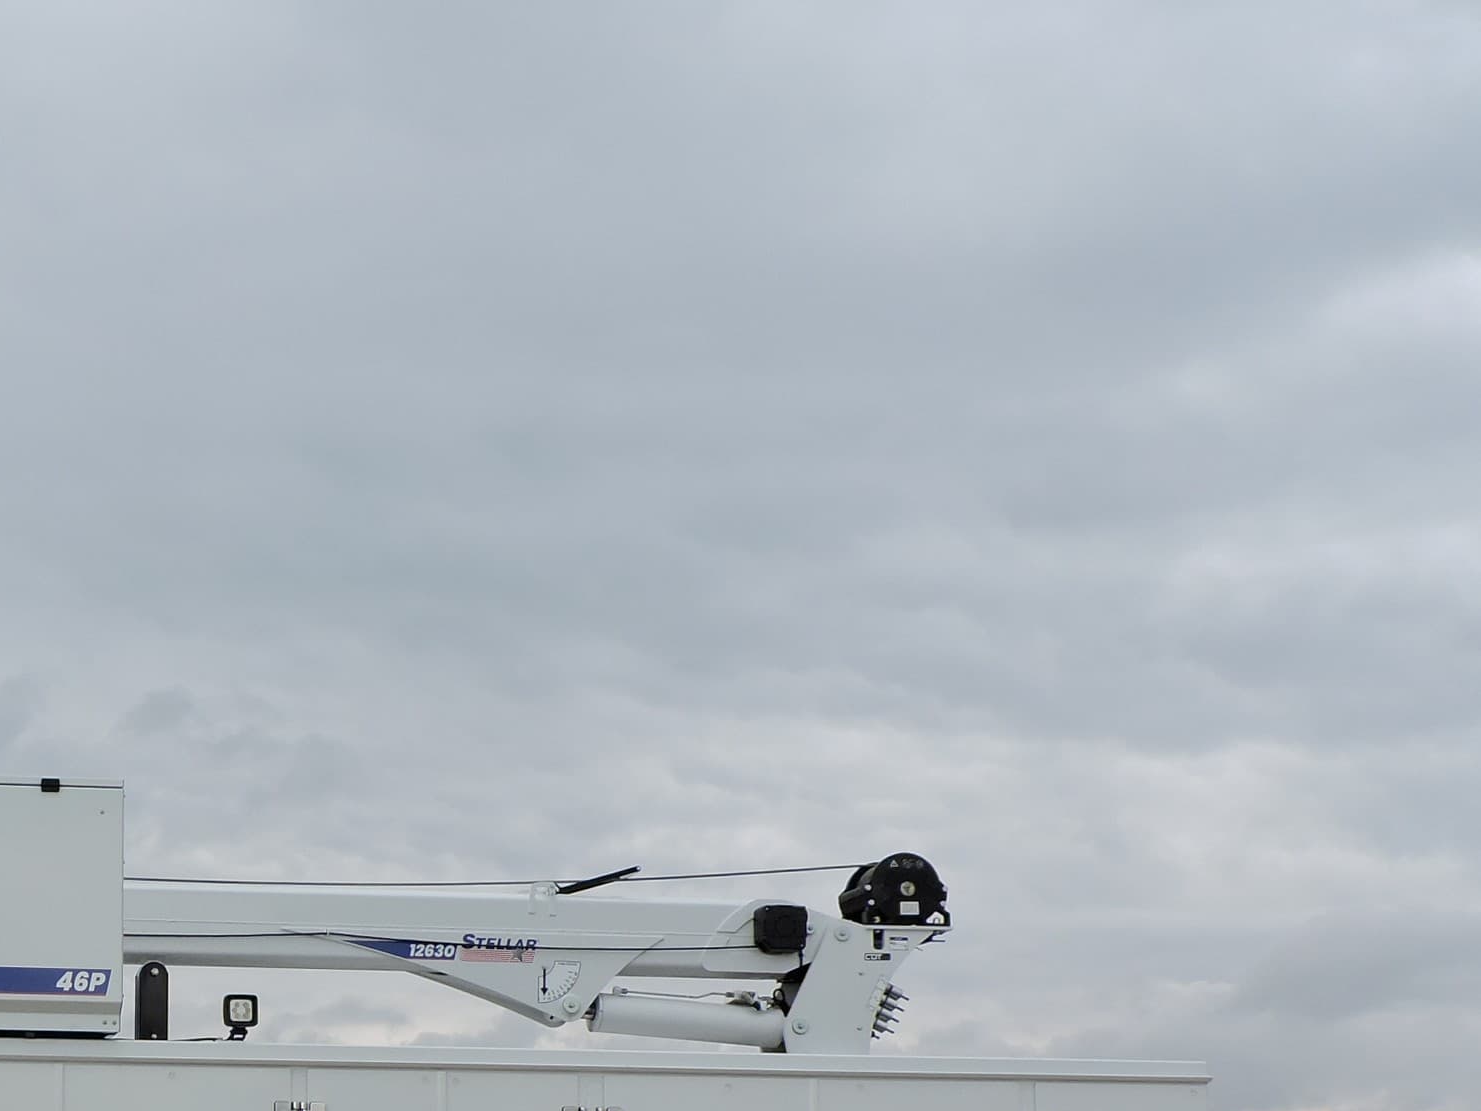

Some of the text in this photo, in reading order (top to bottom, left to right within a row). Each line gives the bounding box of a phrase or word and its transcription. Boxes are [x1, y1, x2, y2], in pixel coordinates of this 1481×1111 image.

[409, 943, 456, 958] 12630
[462, 933, 537, 951] STELLAR
[55, 970, 107, 992] 46P
